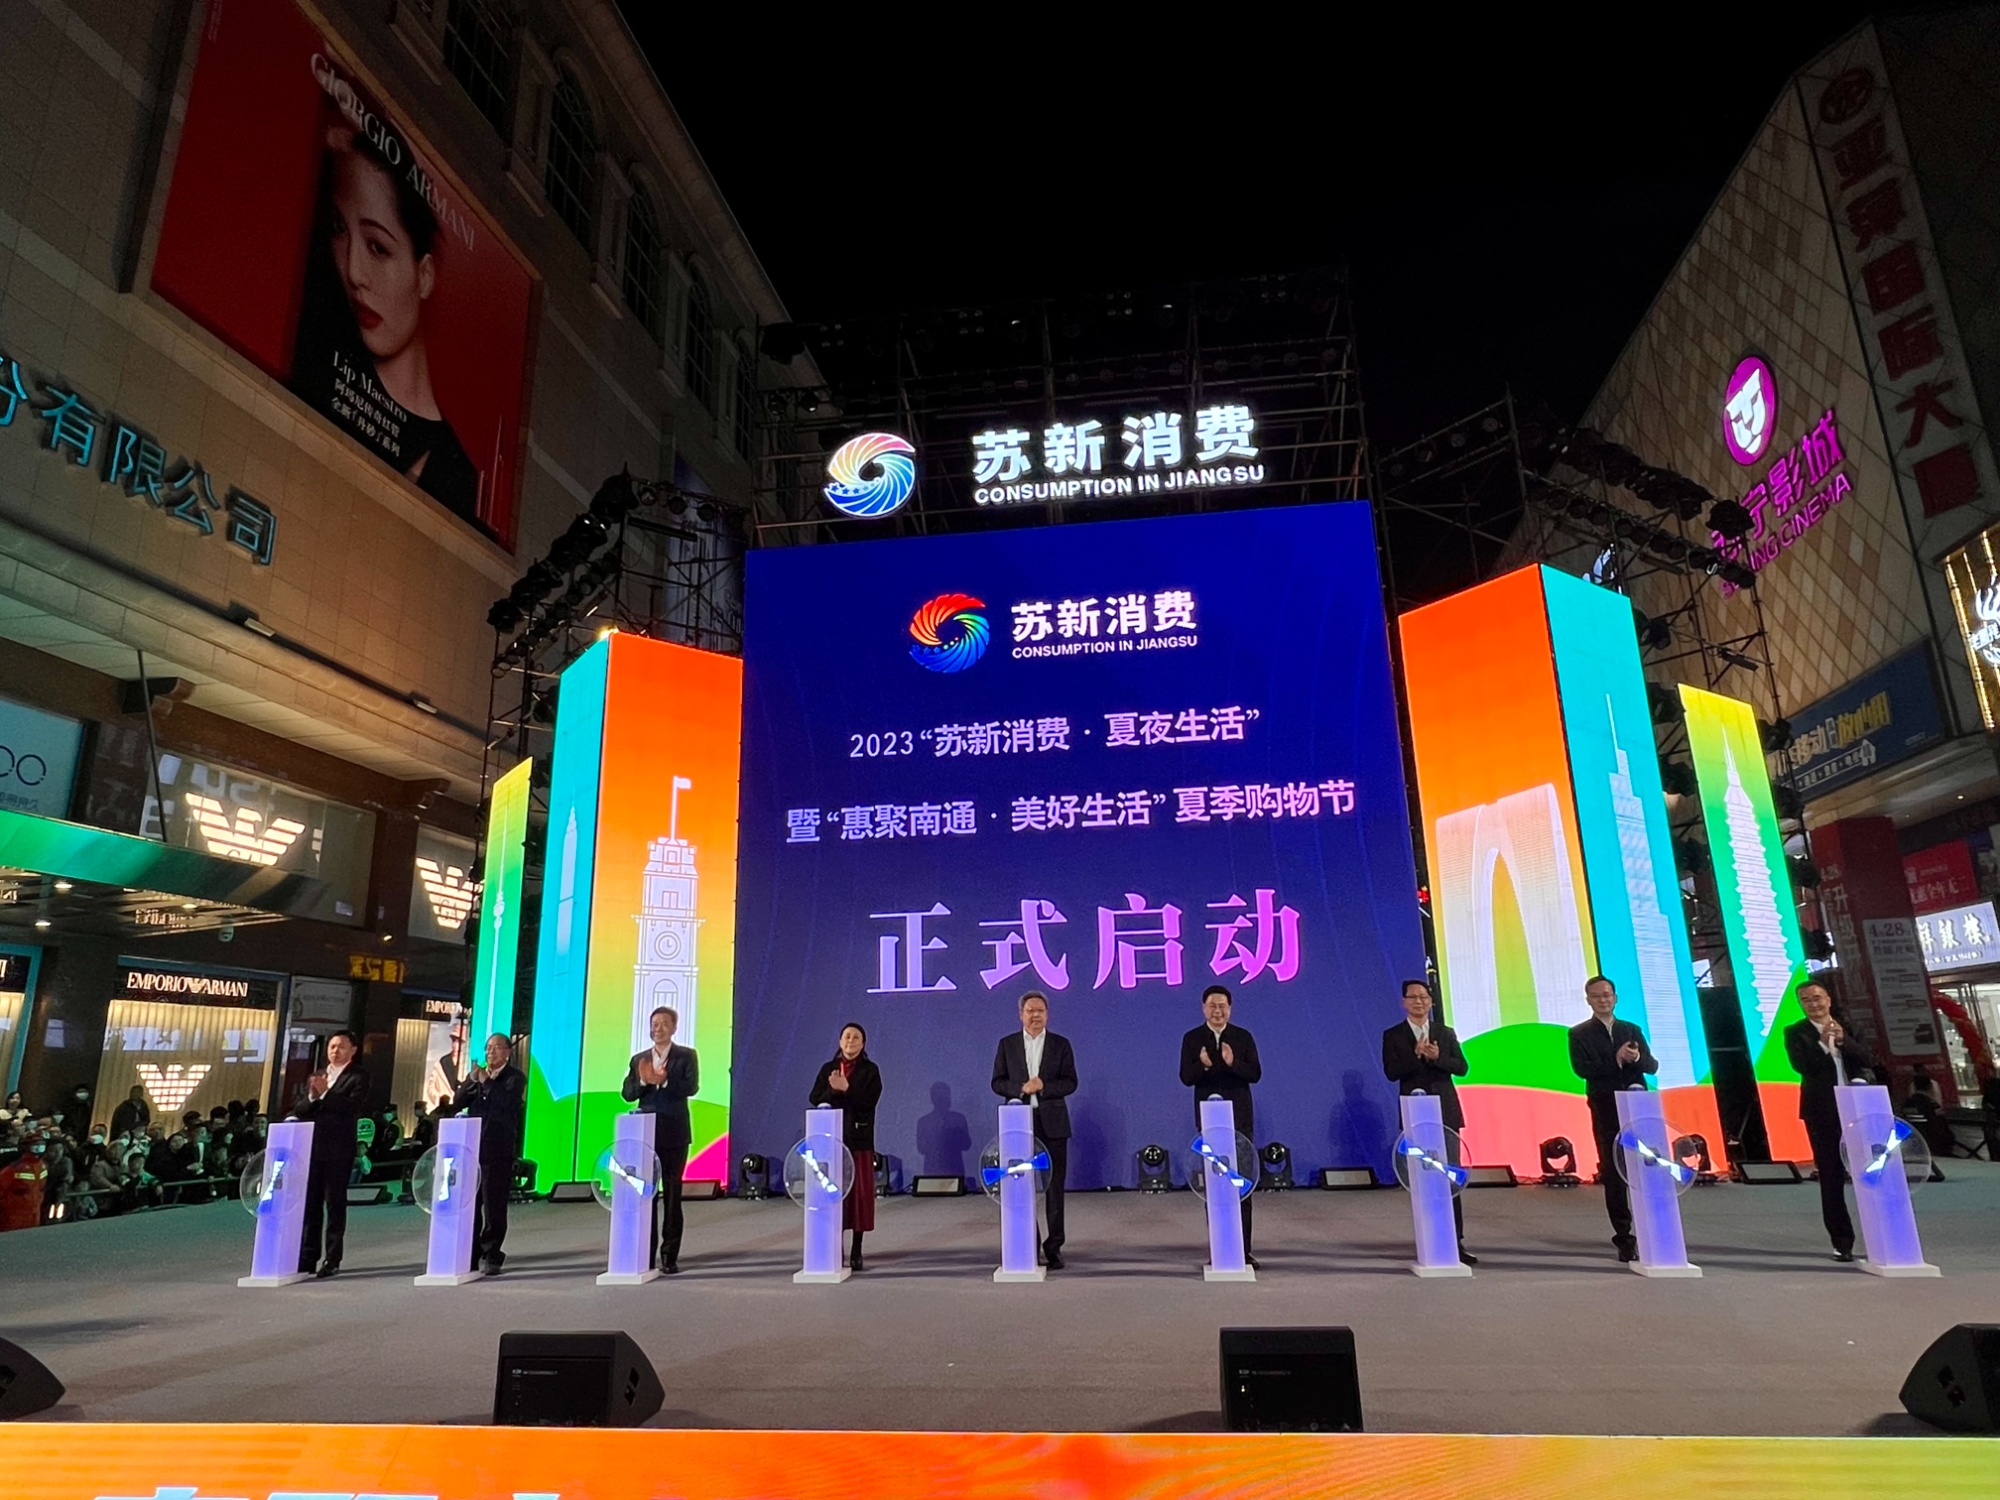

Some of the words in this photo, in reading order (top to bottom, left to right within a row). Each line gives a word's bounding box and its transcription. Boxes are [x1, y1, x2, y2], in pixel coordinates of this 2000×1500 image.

[310, 52, 401, 166] GIORGIO
[405, 163, 475, 252] ARMANI
[333, 350, 356, 385] Lip
[360, 372, 407, 423] Maestro
[972, 404, 1260, 484] 苏新消费
[974, 477, 1133, 507] CONSUMPTION
[1137, 474, 1160, 492] IN
[1164, 464, 1266, 490] JIANGSU
[1780, 472, 1852, 549] CINEMA
[1010, 590, 1198, 643] 苏新消费
[1011, 641, 1115, 659] CONSUMPTION
[1118, 639, 1134, 652] IN
[1136, 634, 1198, 651] JIANGSU
[866, 888, 1302, 995] 正式启动
[126, 971, 188, 993] EMPORIO
[201, 978, 249, 997] ARMANI
